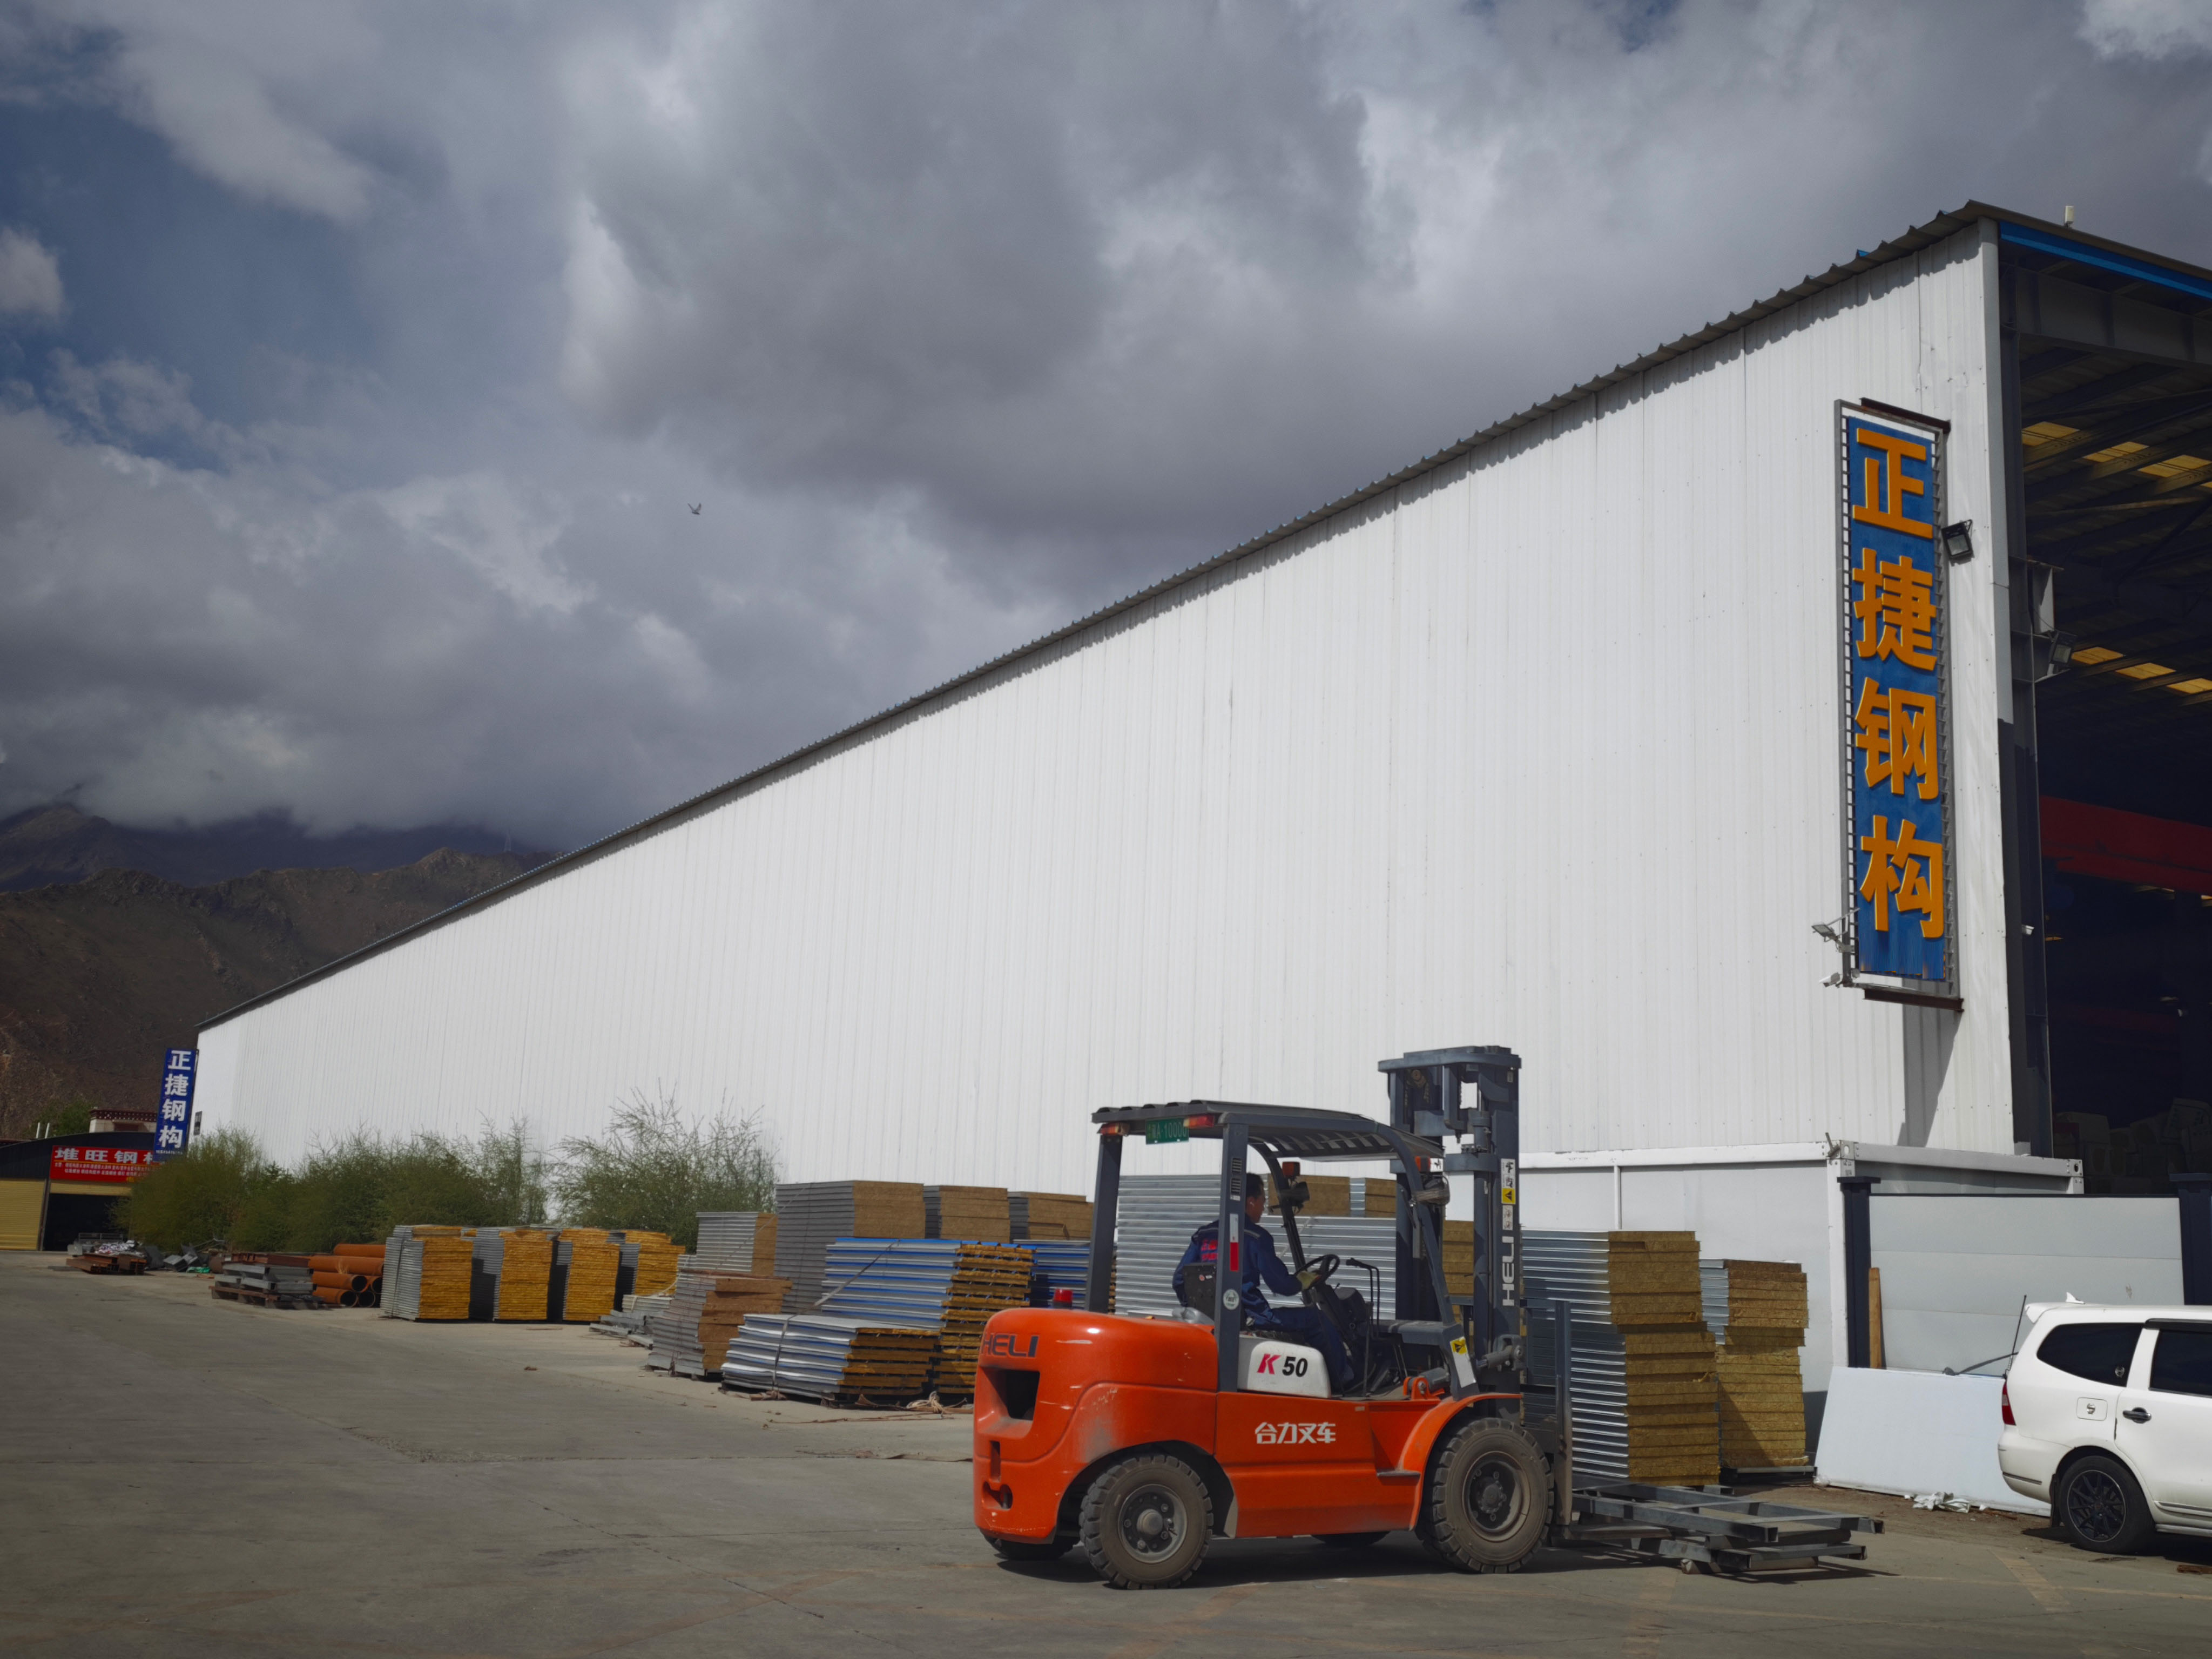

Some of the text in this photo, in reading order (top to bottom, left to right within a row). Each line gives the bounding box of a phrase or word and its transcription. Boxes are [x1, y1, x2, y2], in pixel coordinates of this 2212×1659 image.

[1852, 427, 1944, 939] 正捷钢构
[159, 1050, 192, 1149] 正捷钢构
[1502, 1236, 1514, 1306] HELI
[981, 1333, 1039, 1358] HELI
[1255, 1421, 1336, 1444] 合力叉车
